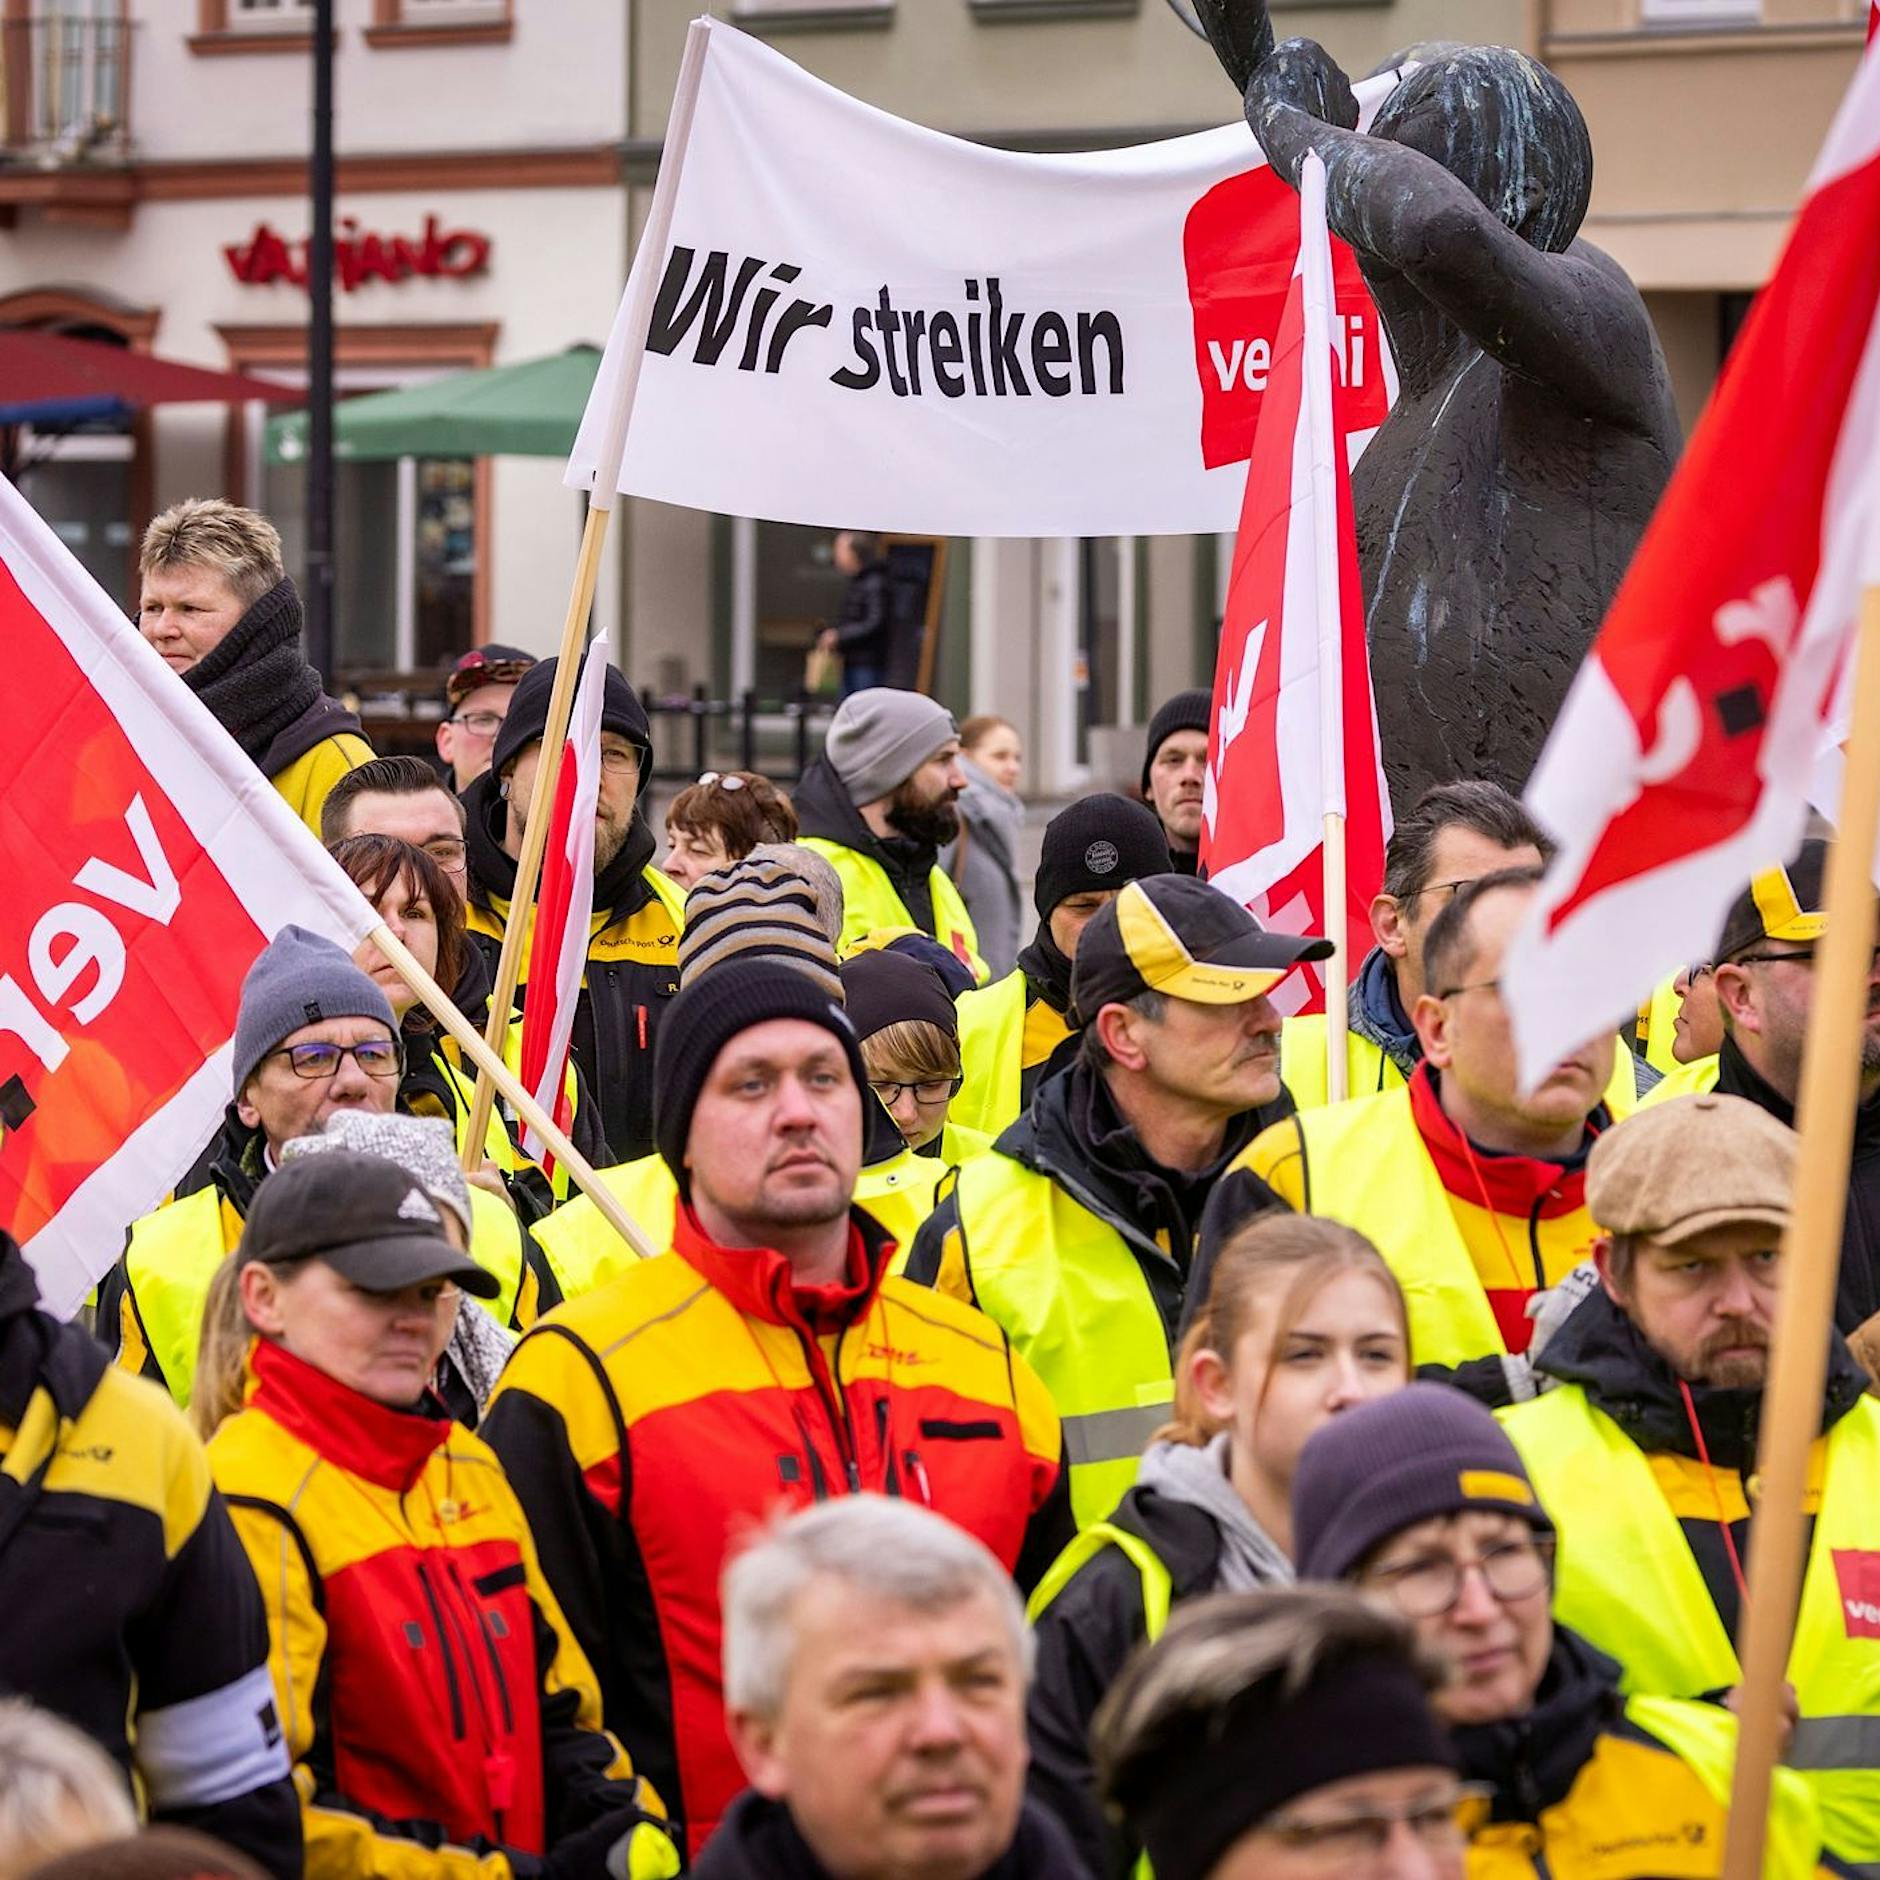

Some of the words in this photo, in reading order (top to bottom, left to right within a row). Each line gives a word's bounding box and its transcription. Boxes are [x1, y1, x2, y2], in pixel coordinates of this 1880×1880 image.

[221, 214, 492, 294] VAIANO
[645, 246, 833, 374] Wir
[829, 278, 1124, 398] streiken
